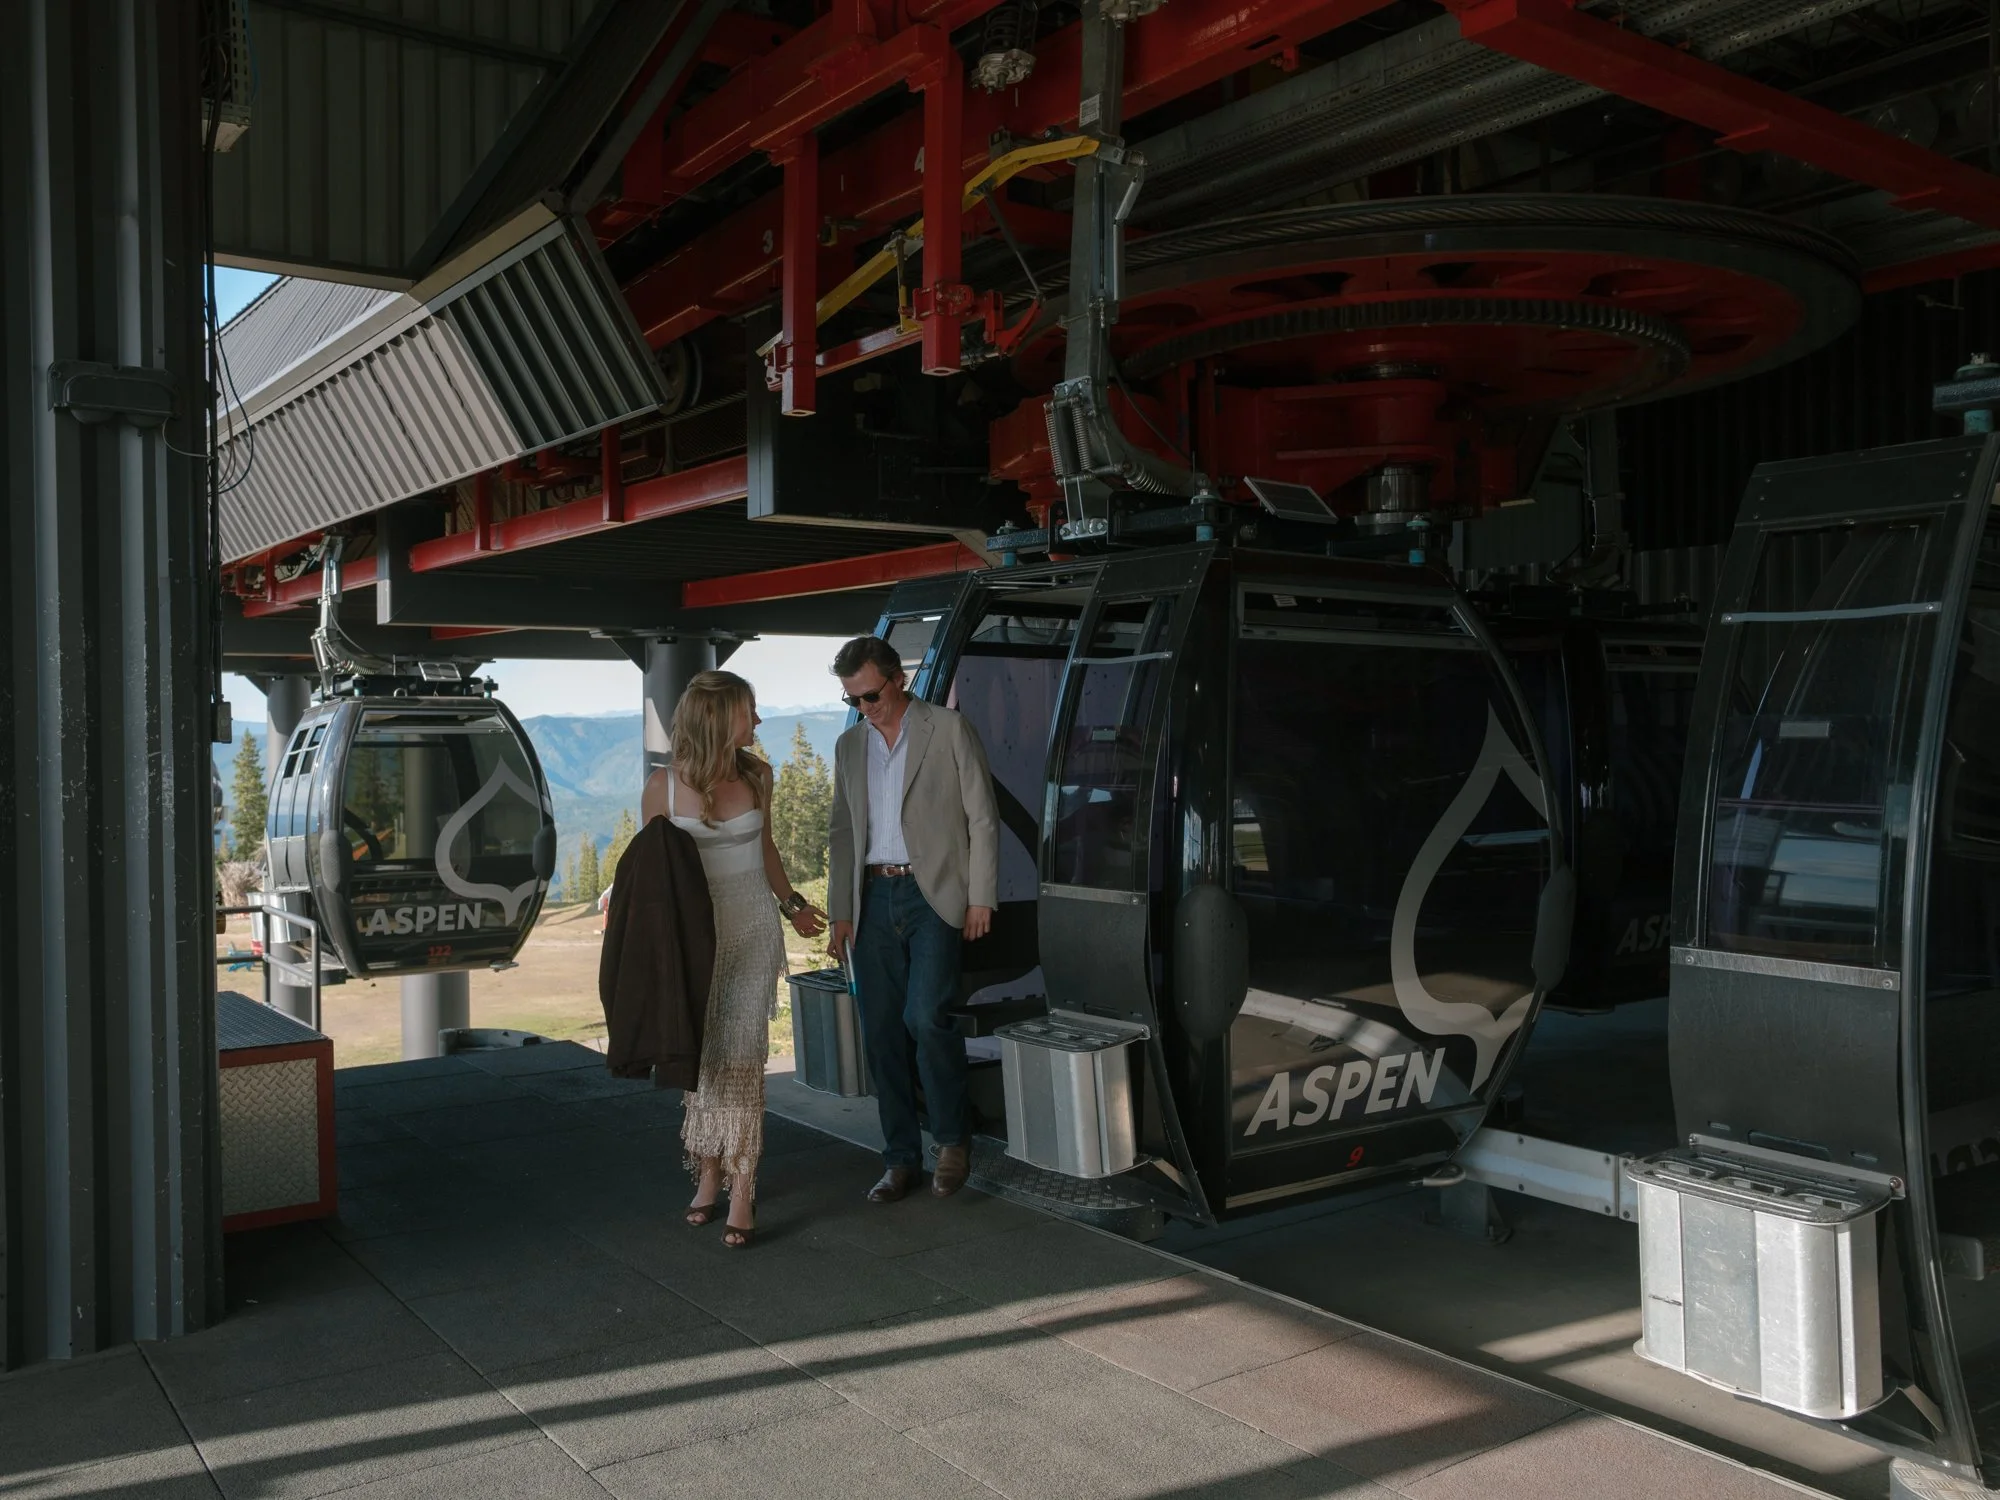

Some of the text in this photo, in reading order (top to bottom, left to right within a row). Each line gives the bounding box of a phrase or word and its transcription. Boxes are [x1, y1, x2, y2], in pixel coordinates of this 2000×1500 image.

[762, 229, 773, 254] 3
[365, 902, 481, 936] ASPEN
[1615, 913, 1670, 955] ASP
[428, 945, 452, 956] 122
[1243, 1047, 1446, 1136] ASPEN
[1346, 1146, 1364, 1168] 9
